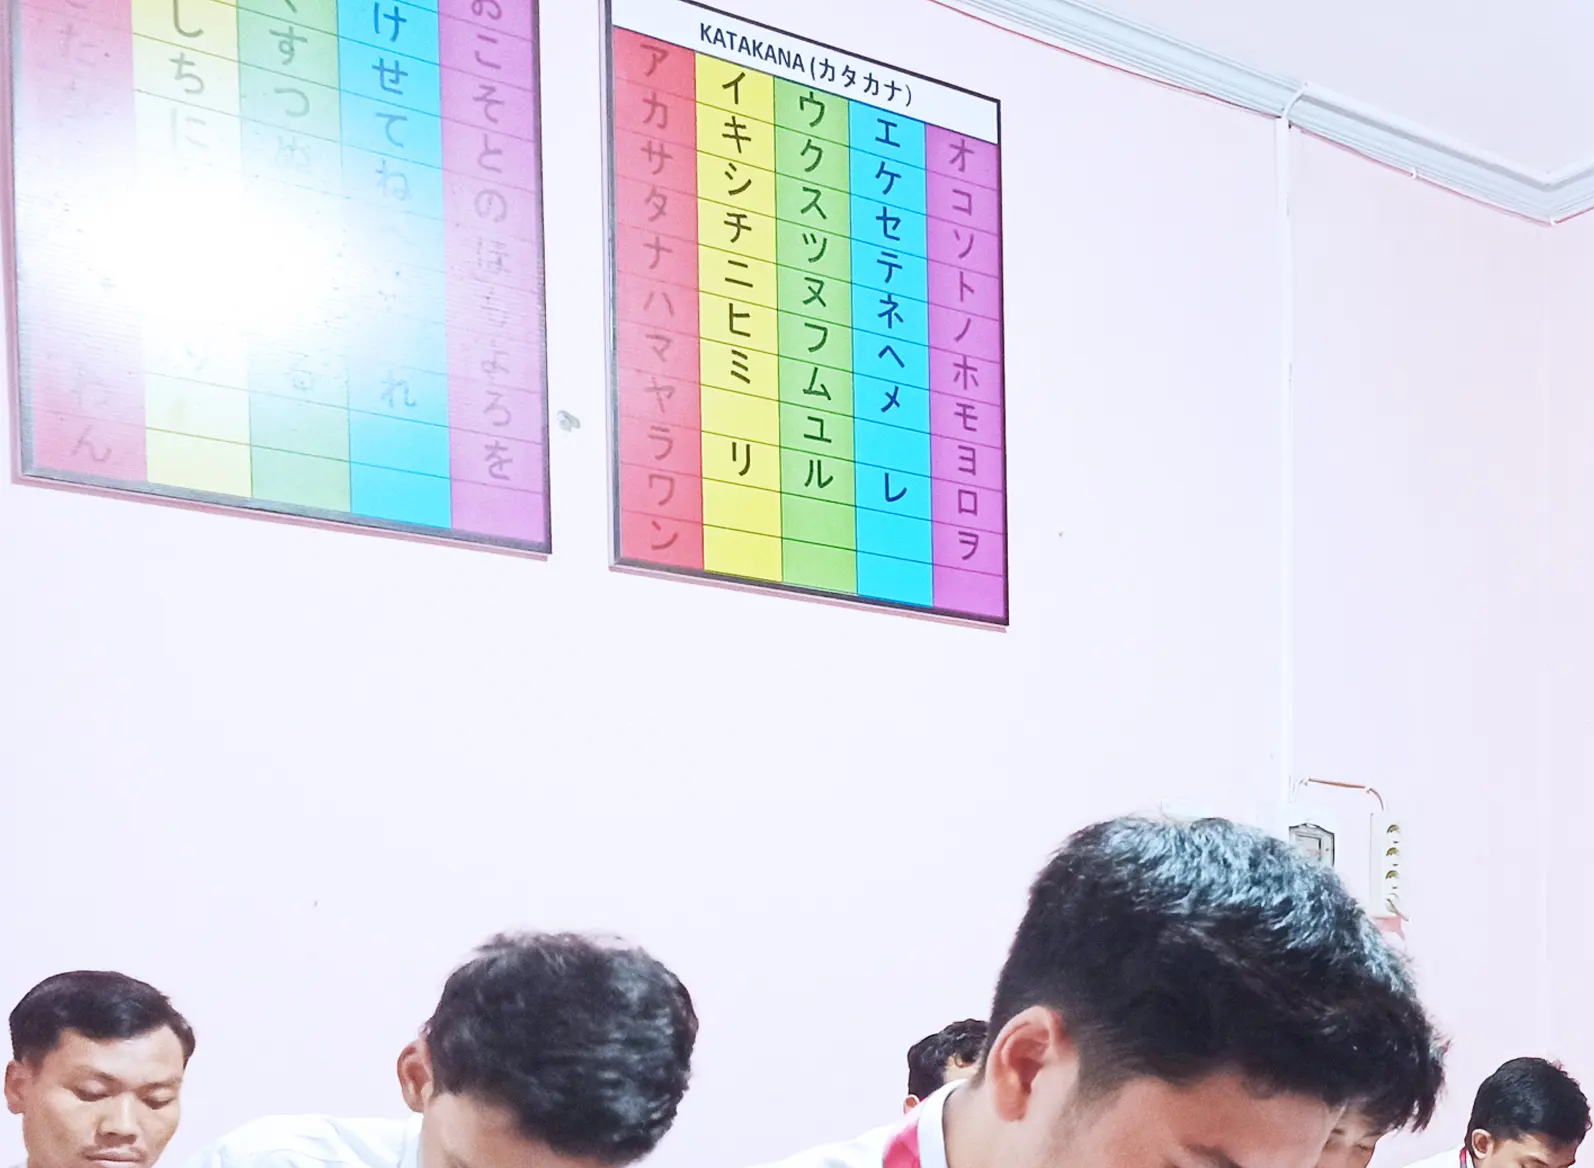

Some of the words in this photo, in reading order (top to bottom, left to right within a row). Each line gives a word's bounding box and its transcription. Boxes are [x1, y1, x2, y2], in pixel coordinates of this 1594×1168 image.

[270, 26, 308, 66] す
[372, 59, 408, 96] せ
[472, 84, 506, 125] そ
[374, 6, 407, 43] け
[476, 33, 502, 71] こ
[699, 23, 806, 74] KATAKANA
[810, 56, 913, 108] (カタカナ)
[169, 54, 205, 95] ち
[273, 86, 310, 119] つ
[374, 112, 409, 148] て
[477, 133, 504, 175] と
[640, 44, 668, 76] ア
[722, 72, 745, 104] イ
[800, 92, 825, 127] ウ
[875, 119, 900, 147] エ
[950, 139, 974, 172] オ
[643, 92, 667, 129] カ
[722, 116, 751, 153] キ
[801, 139, 823, 172] ク
[876, 161, 901, 194] ケ
[953, 189, 972, 215] コ
[171, 106, 207, 150] に
[375, 159, 412, 201] ね
[474, 188, 508, 223] の
[641, 140, 673, 175] サ
[725, 163, 751, 195] シ
[801, 187, 826, 219] ス
[876, 206, 901, 240] セ
[954, 230, 974, 258] ソ
[644, 236, 673, 269] ナ
[803, 277, 826, 307] ヌ
[878, 292, 903, 328] ネ
[955, 318, 971, 342] ノ
[645, 185, 667, 222] タ
[724, 213, 751, 243] チ
[803, 233, 827, 262] ツ
[877, 252, 902, 283] テ
[960, 271, 974, 301] ト
[644, 292, 674, 316] ハ
[729, 303, 750, 337] ヒ
[805, 323, 827, 352] フ
[953, 354, 978, 390] ホ
[646, 334, 673, 362] マ
[731, 350, 750, 384] ミ
[803, 367, 831, 400] ム
[881, 386, 900, 412] メ
[955, 403, 977, 431] モ
[71, 424, 112, 465] ん
[482, 388, 512, 427] ろ
[646, 376, 678, 414] ヤ
[804, 416, 831, 443] ユ
[958, 445, 976, 475] ヨ
[485, 441, 514, 481] を
[649, 426, 673, 460] ラ
[732, 442, 750, 476] リ
[805, 460, 833, 488] ル
[885, 473, 907, 502] レ
[649, 474, 674, 506] ワ
[958, 531, 978, 560] ヲ
[652, 521, 678, 550] ン
